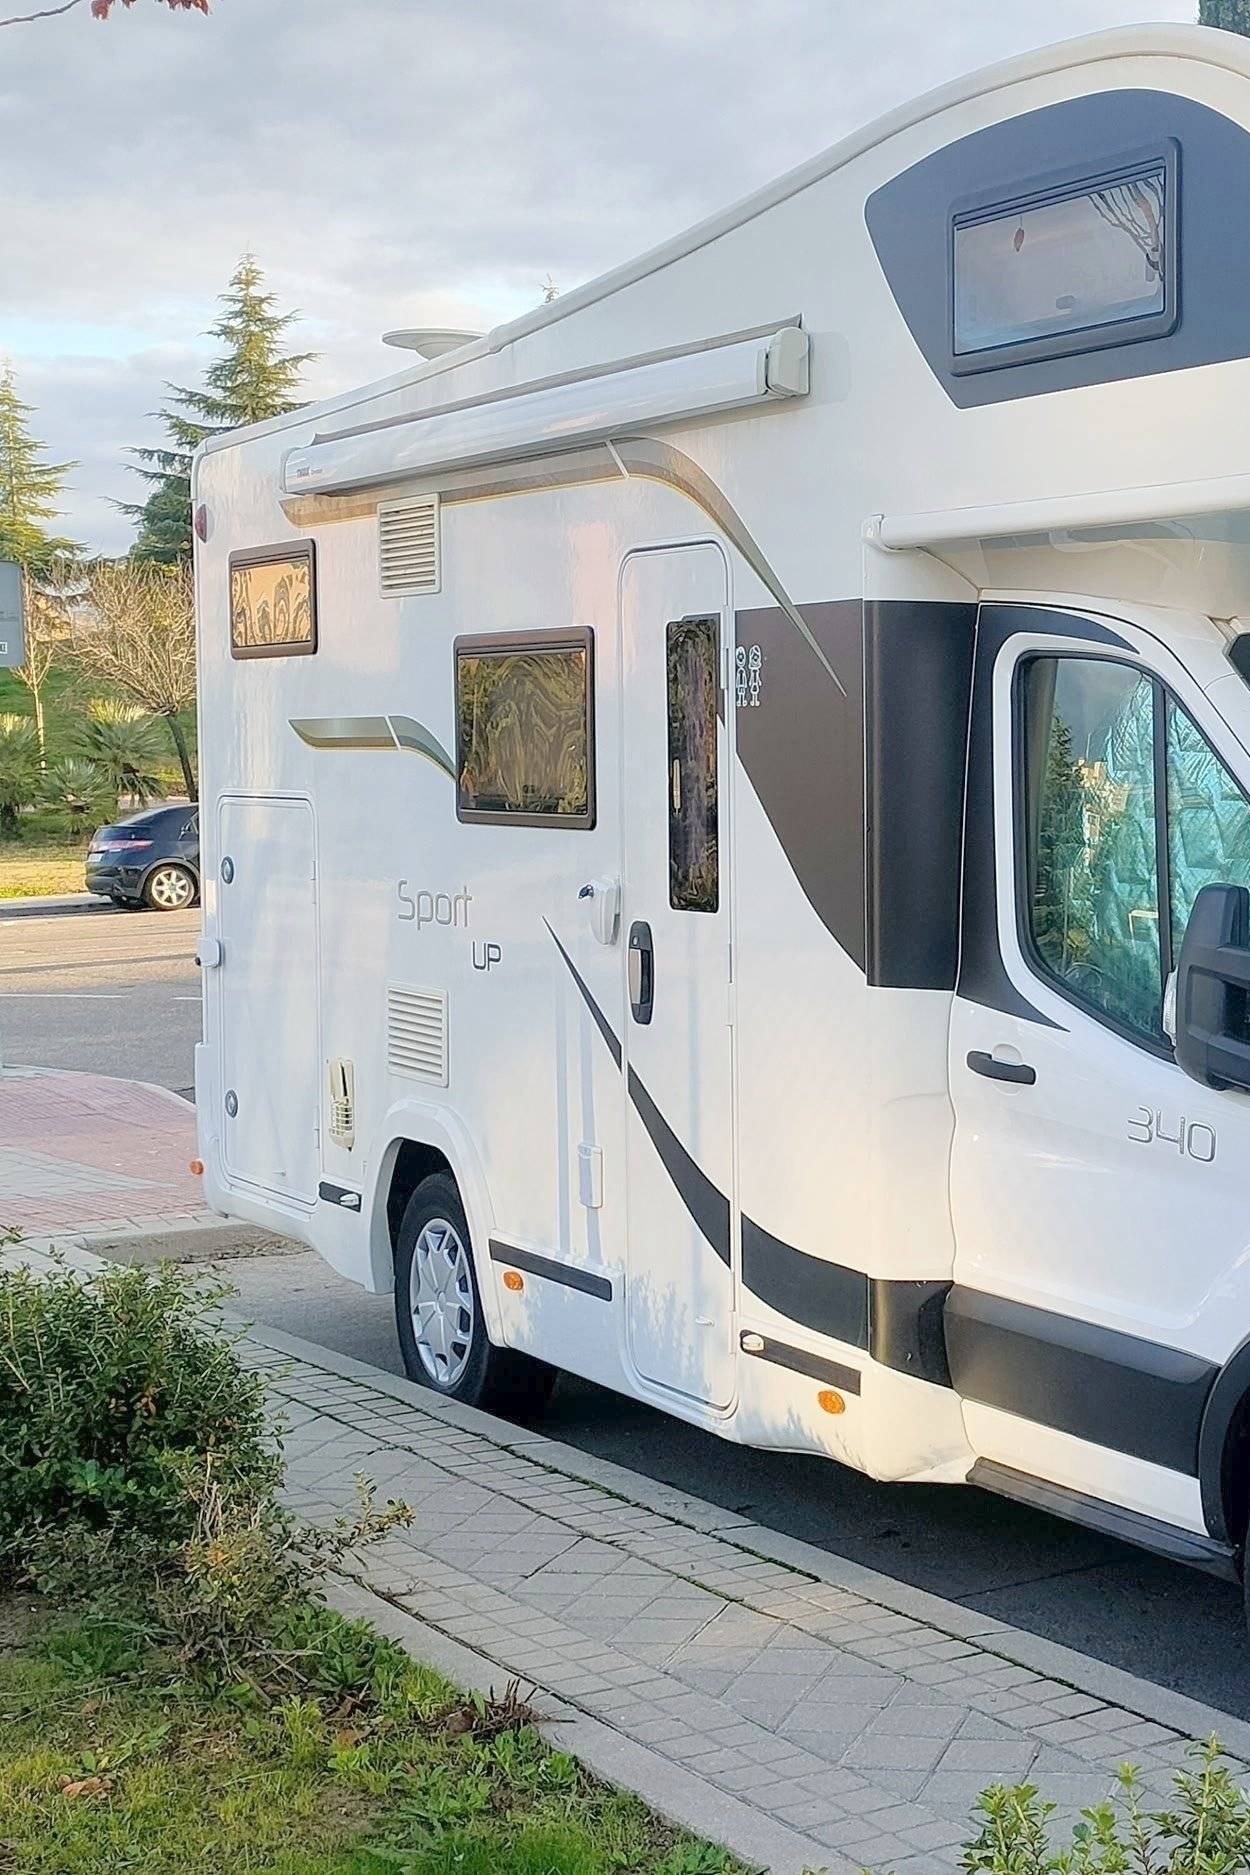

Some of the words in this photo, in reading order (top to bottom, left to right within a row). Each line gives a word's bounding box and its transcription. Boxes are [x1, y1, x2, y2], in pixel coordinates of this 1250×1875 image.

[398, 879, 472, 931] Sport
[472, 941, 501, 971] UP
[1127, 1105, 1216, 1162] 340
